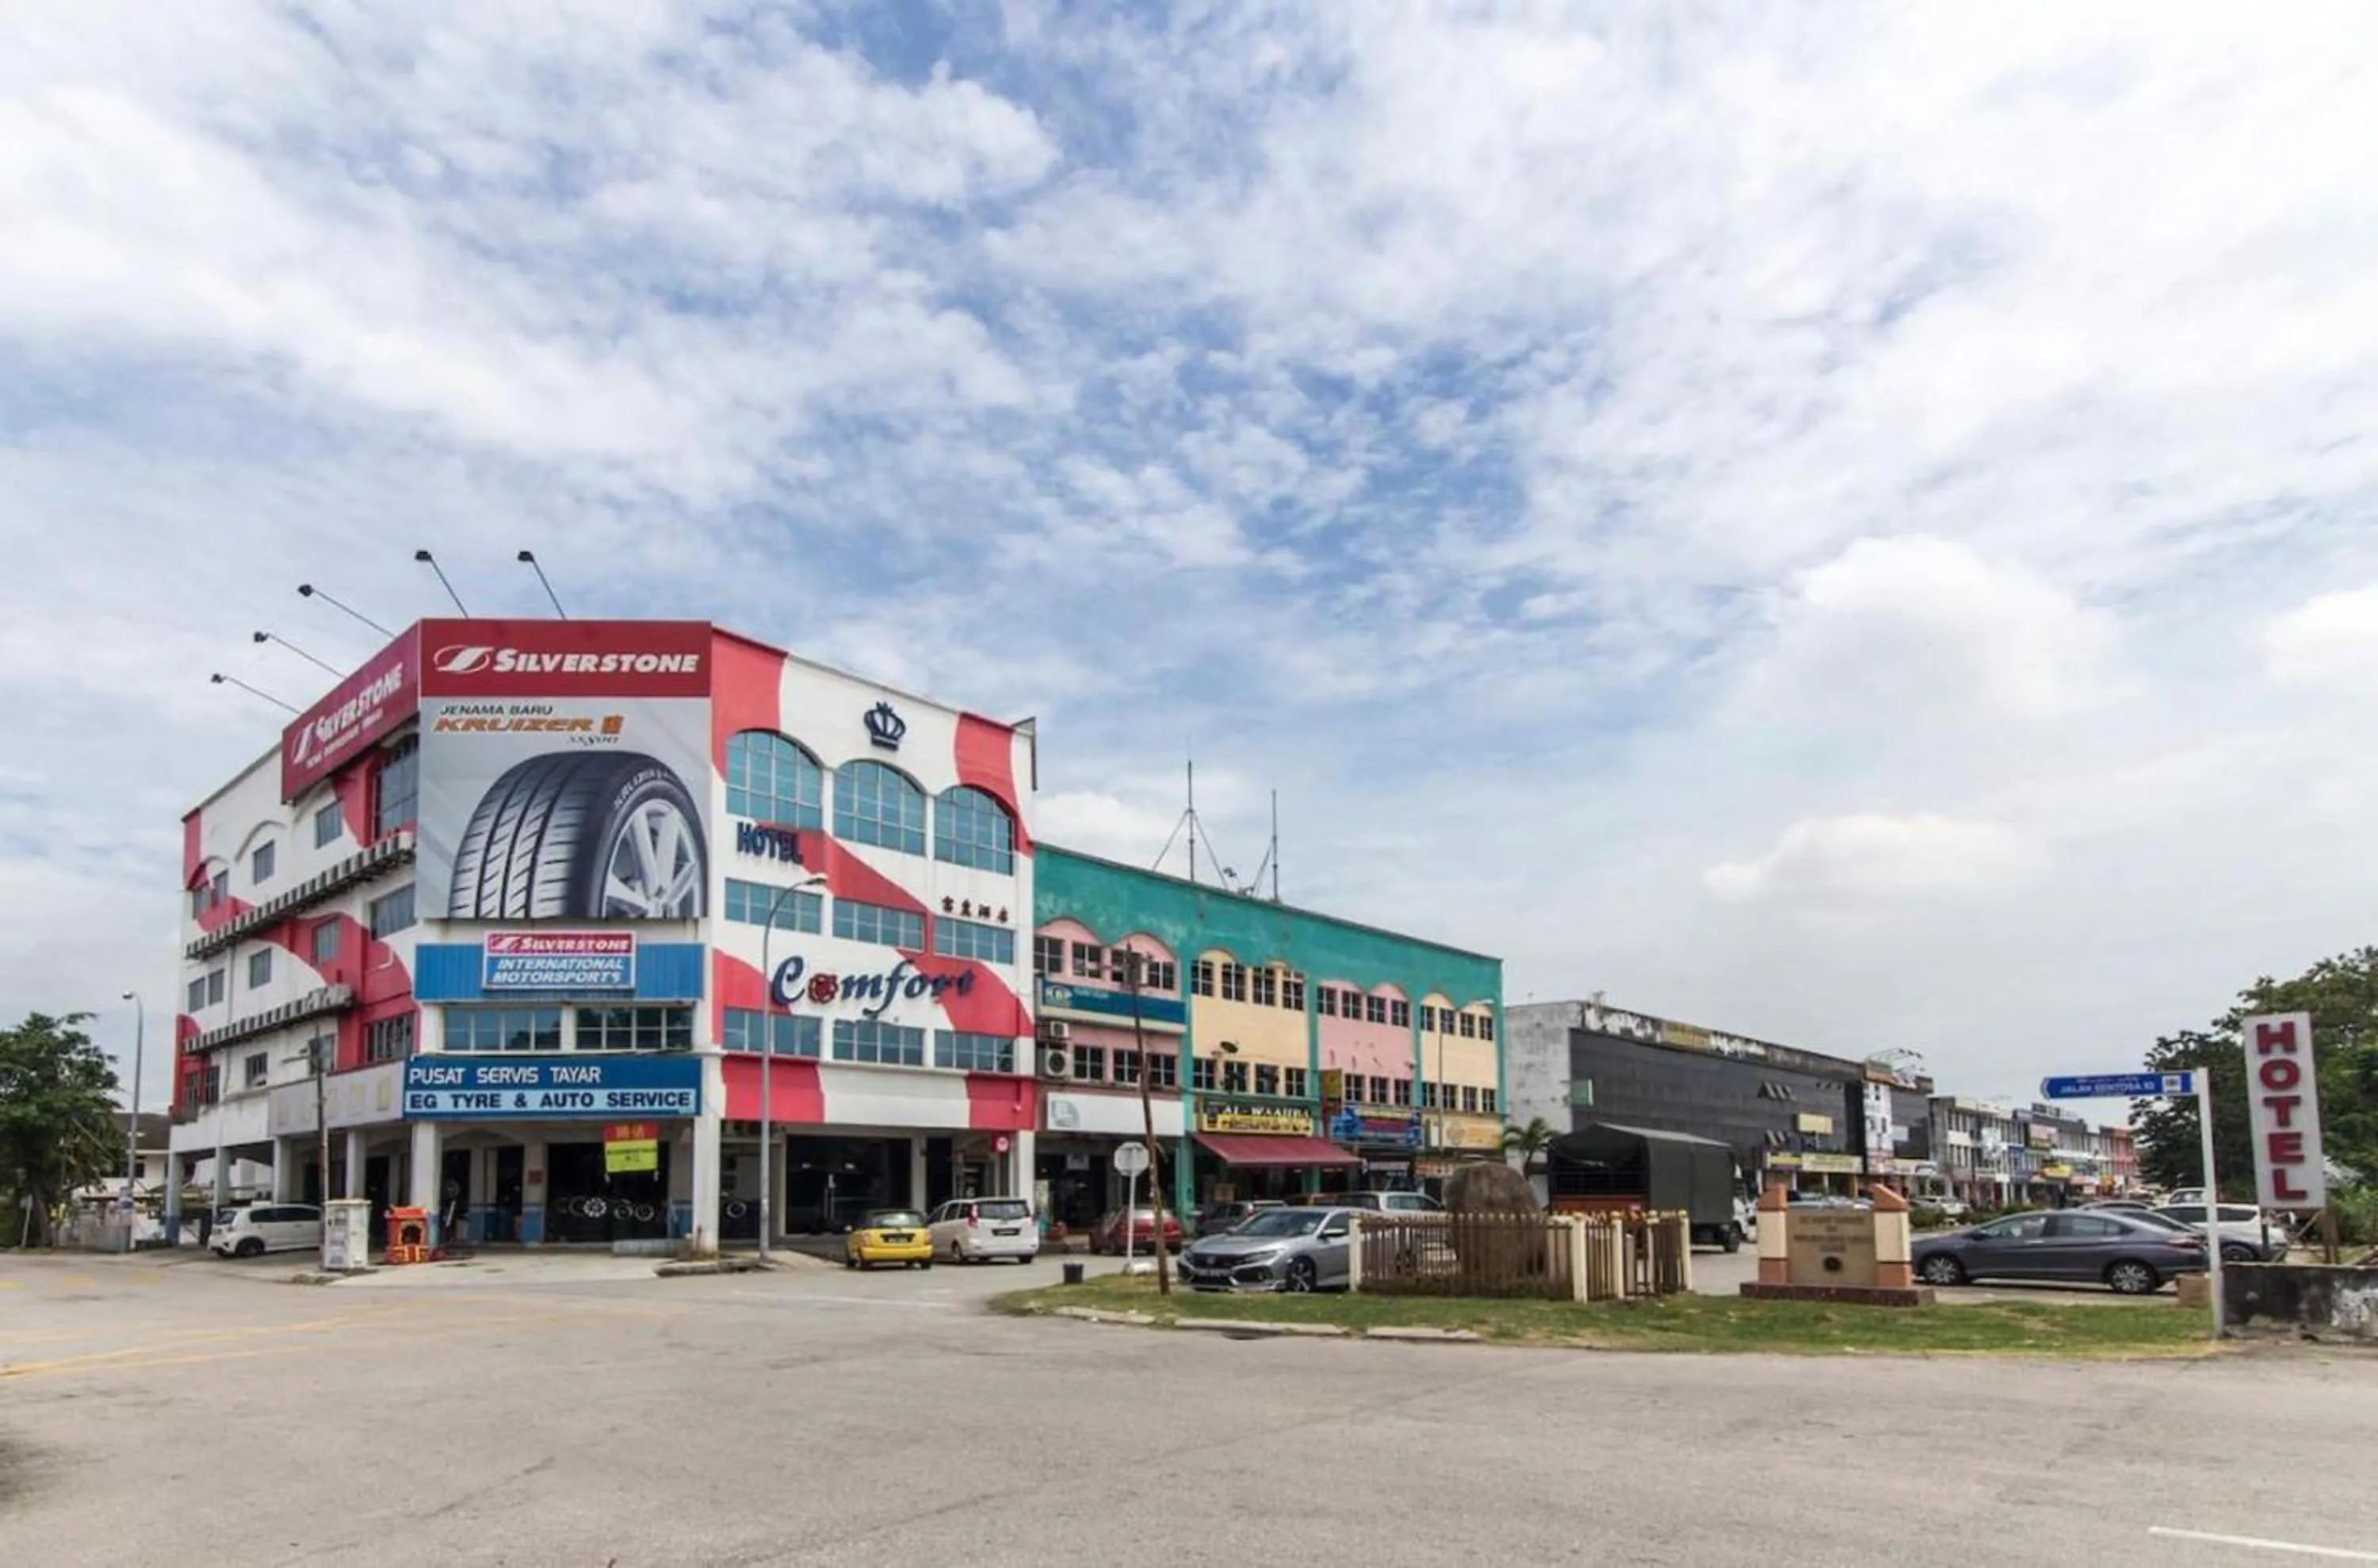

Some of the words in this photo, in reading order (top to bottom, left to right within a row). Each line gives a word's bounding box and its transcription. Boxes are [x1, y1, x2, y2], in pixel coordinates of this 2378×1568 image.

[492, 648, 699, 673] SILVERSTONE
[440, 705, 505, 715] JENAMA
[434, 717, 594, 732] KRUIZER
[738, 821, 804, 865] HOTEL
[520, 936, 630, 951] SILVERSTONE
[497, 958, 625, 970] INTERNATIONAL
[491, 971, 622, 984] MOTORSPORTS
[409, 1068, 466, 1084] PUSAT
[477, 1067, 540, 1084] SERVIS
[550, 1066, 602, 1083] TAYAR
[410, 1094, 437, 1110] EG
[450, 1093, 502, 1109] TYRE
[514, 1093, 528, 1108] &
[539, 1092, 594, 1108] AUTO
[606, 1092, 691, 1108] SERVICE
[2256, 1020, 2307, 1201] HOTEL
